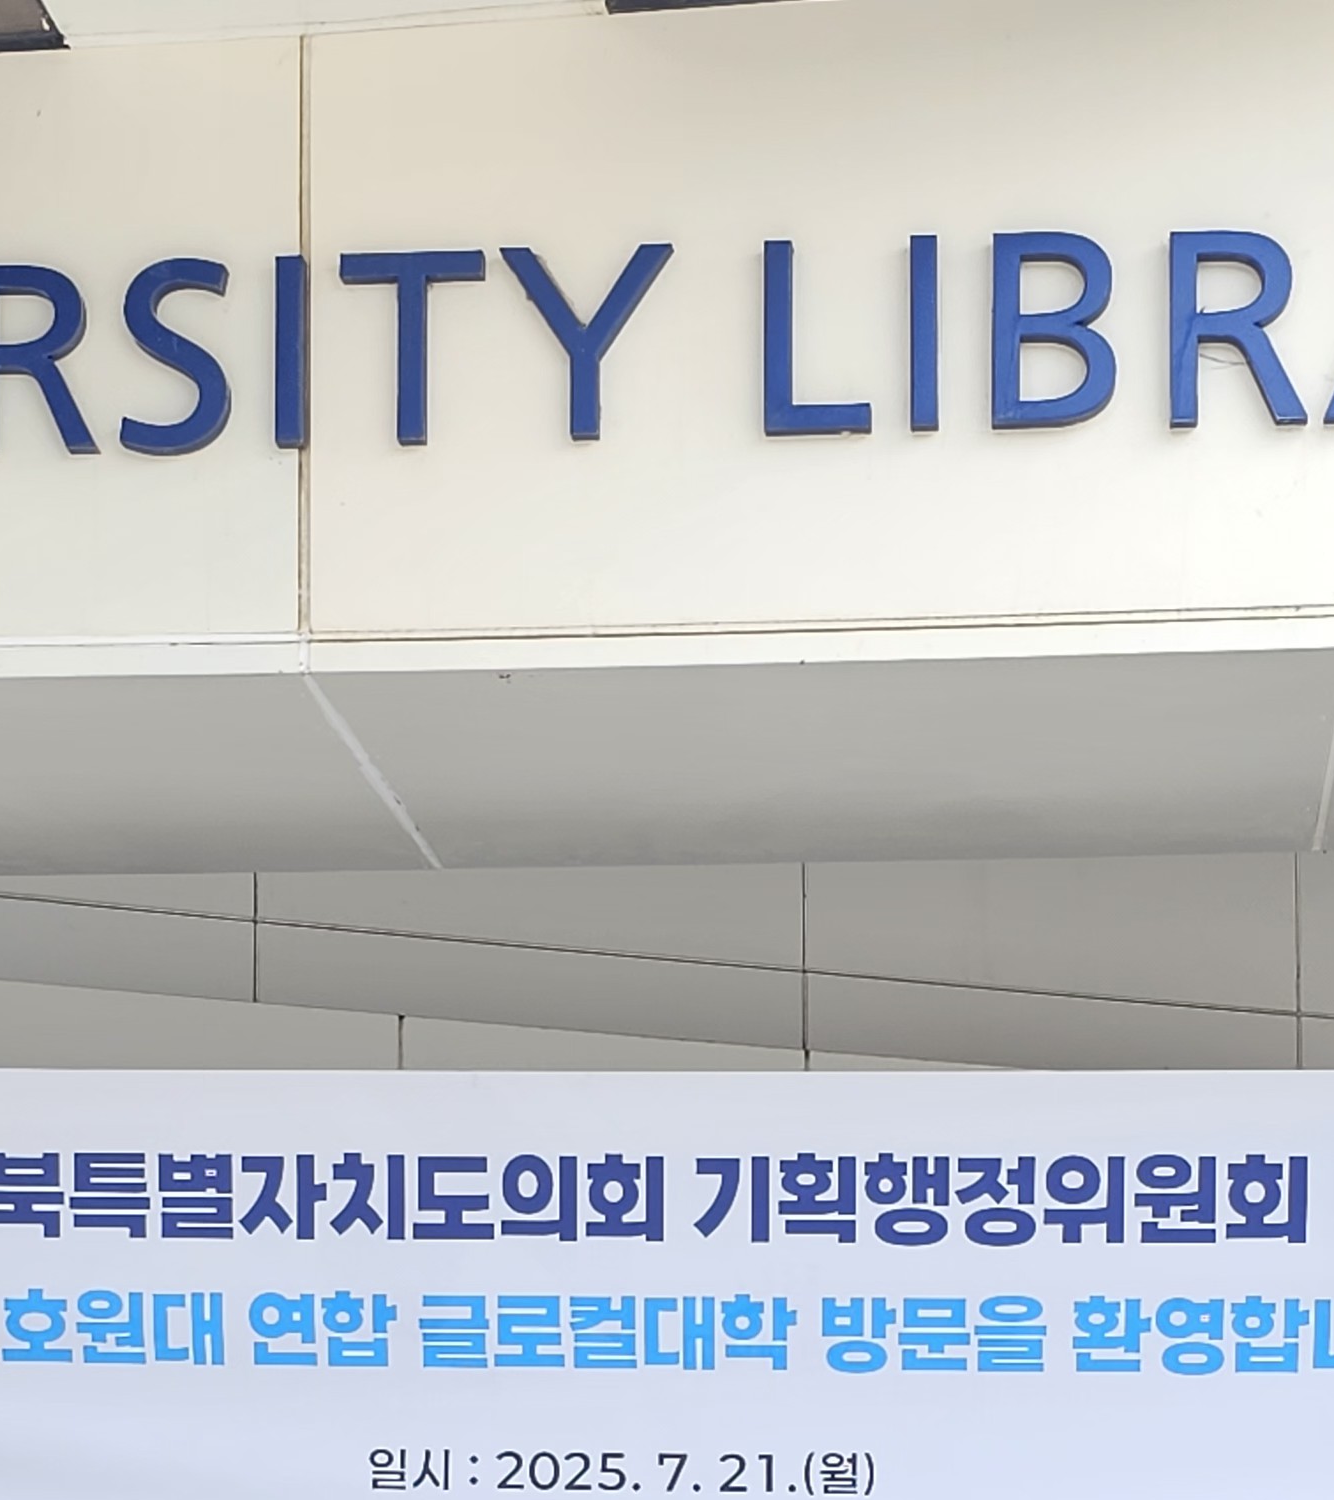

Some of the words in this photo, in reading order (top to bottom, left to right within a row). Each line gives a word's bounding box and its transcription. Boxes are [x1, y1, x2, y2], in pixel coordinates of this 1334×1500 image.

[692, 1152, 1309, 1248] 기획행정위원회
[248, 1290, 398, 1368] 연합
[417, 1293, 798, 1371] 글로컬대학
[821, 1295, 1048, 1375] 방문을
[495, 1450, 642, 1492] 2025.
[657, 1452, 702, 1493] 7.
